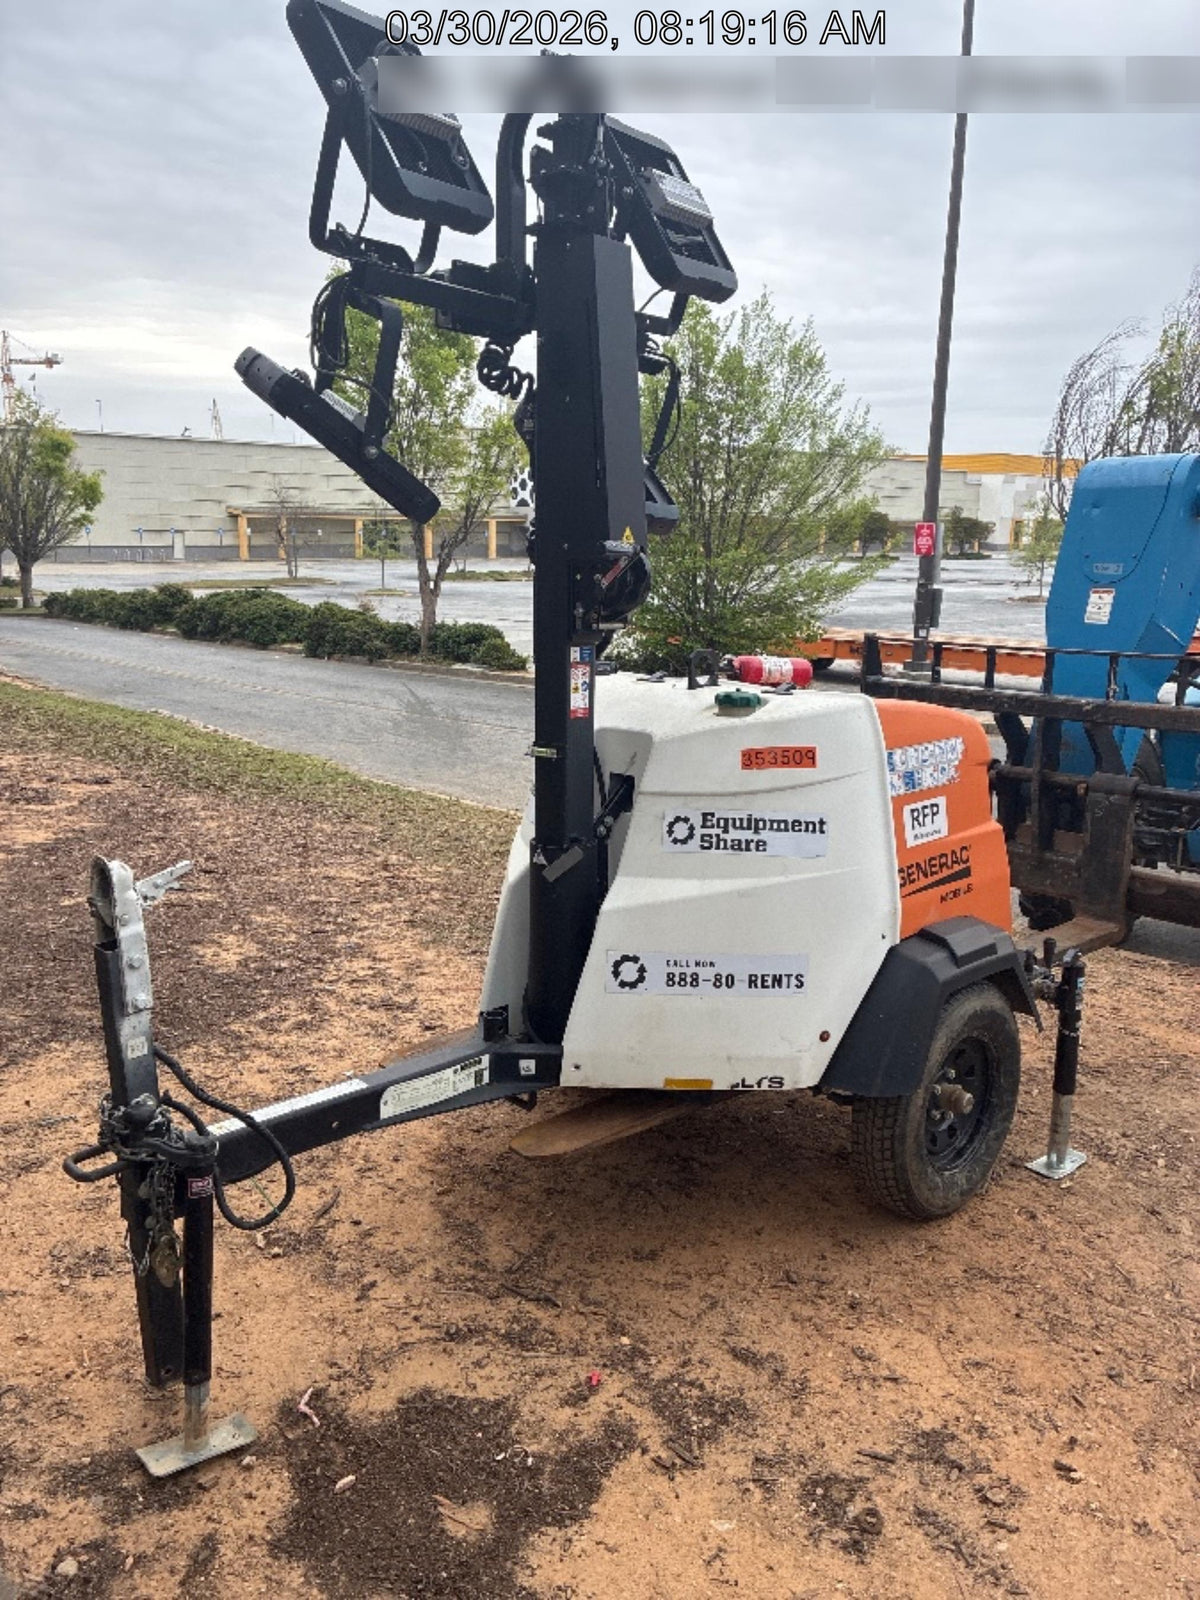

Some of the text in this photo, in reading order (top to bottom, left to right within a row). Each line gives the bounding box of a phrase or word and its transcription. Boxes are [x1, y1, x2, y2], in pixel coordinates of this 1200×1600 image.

[742, 749, 816, 767] 353509
[700, 812, 827, 835] Equipment
[910, 803, 940, 830] RFP
[699, 833, 768, 852] Share
[898, 845, 970, 889] GENERAC
